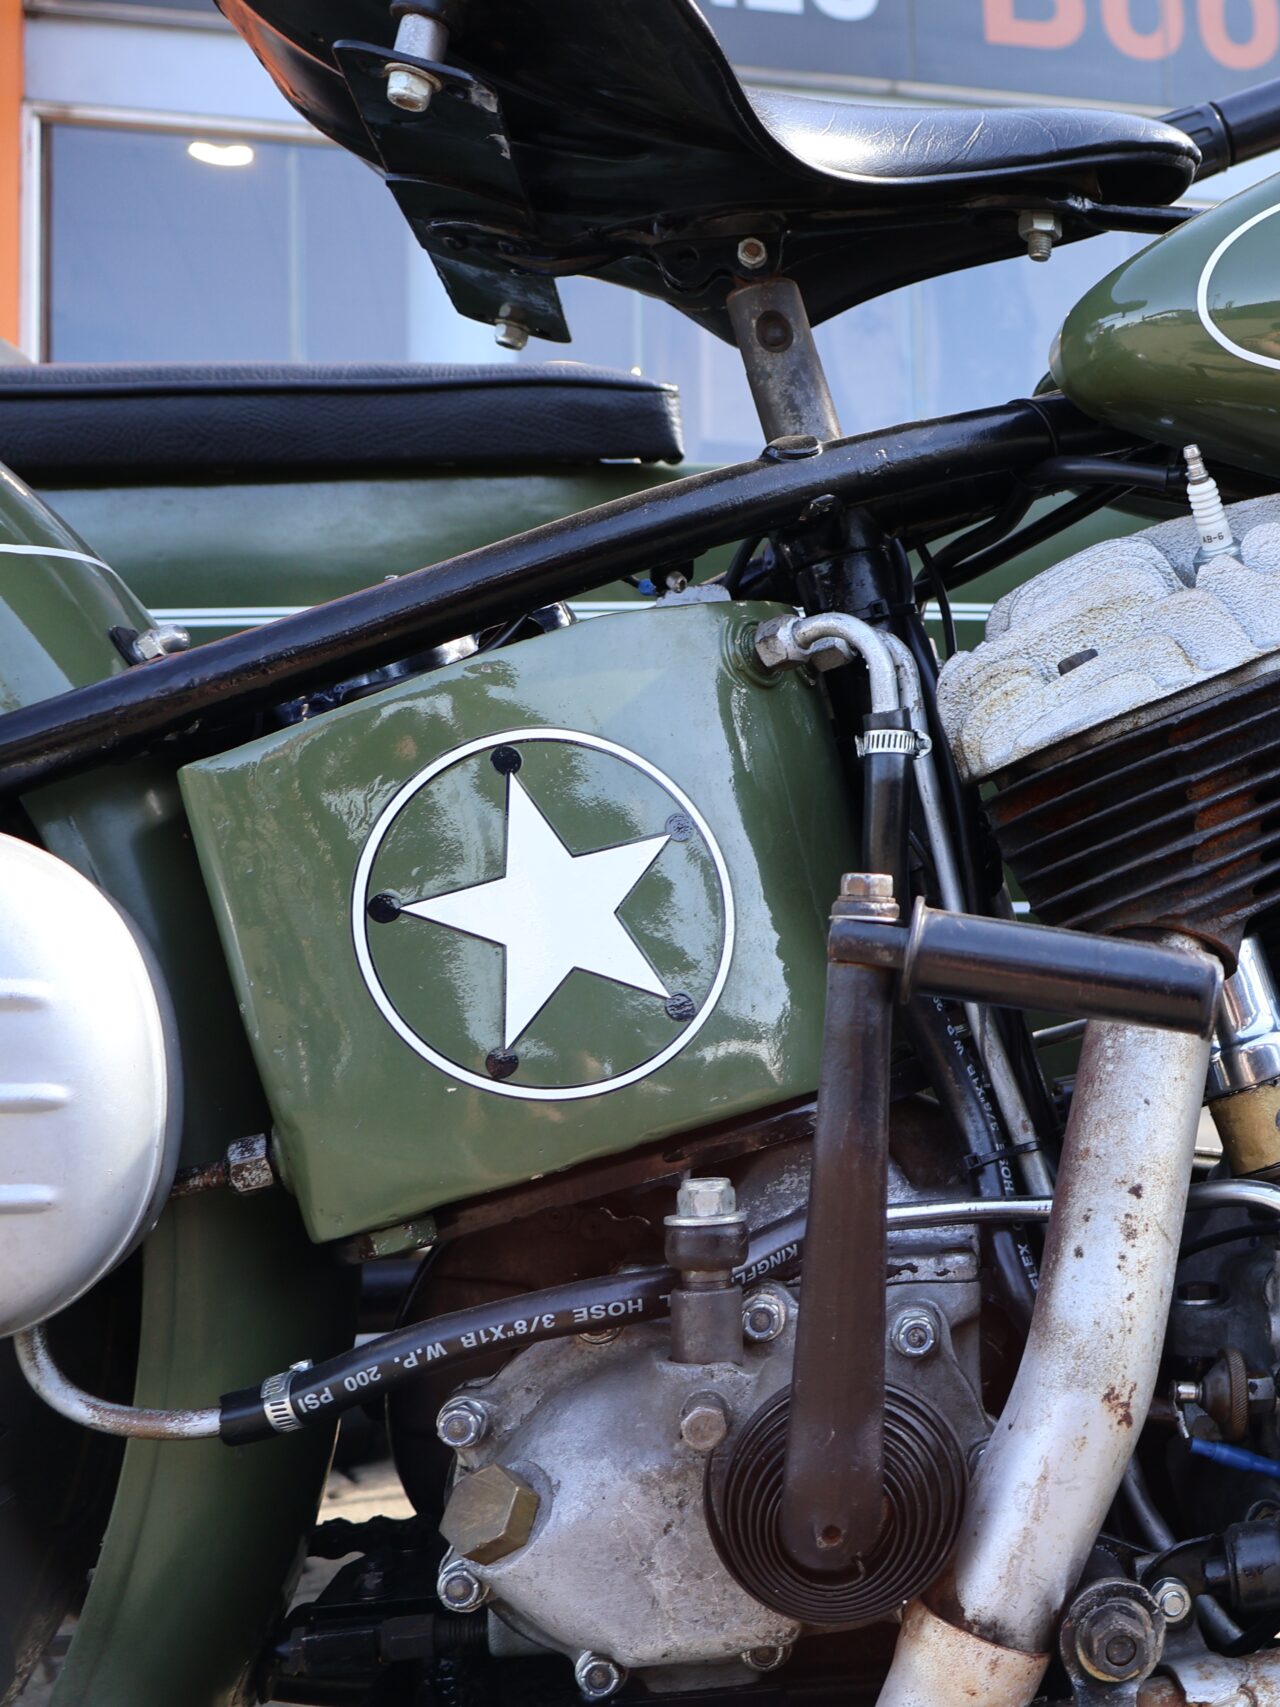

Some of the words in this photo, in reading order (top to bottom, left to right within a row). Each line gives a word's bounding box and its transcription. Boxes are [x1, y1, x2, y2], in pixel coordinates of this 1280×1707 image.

[731, 1243, 799, 1285] KINGFL
[572, 1298, 644, 1324] HOSE
[393, 1341, 448, 1370] W.P.
[343, 1365, 382, 1392] 200
[297, 1386, 335, 1414] PSI
